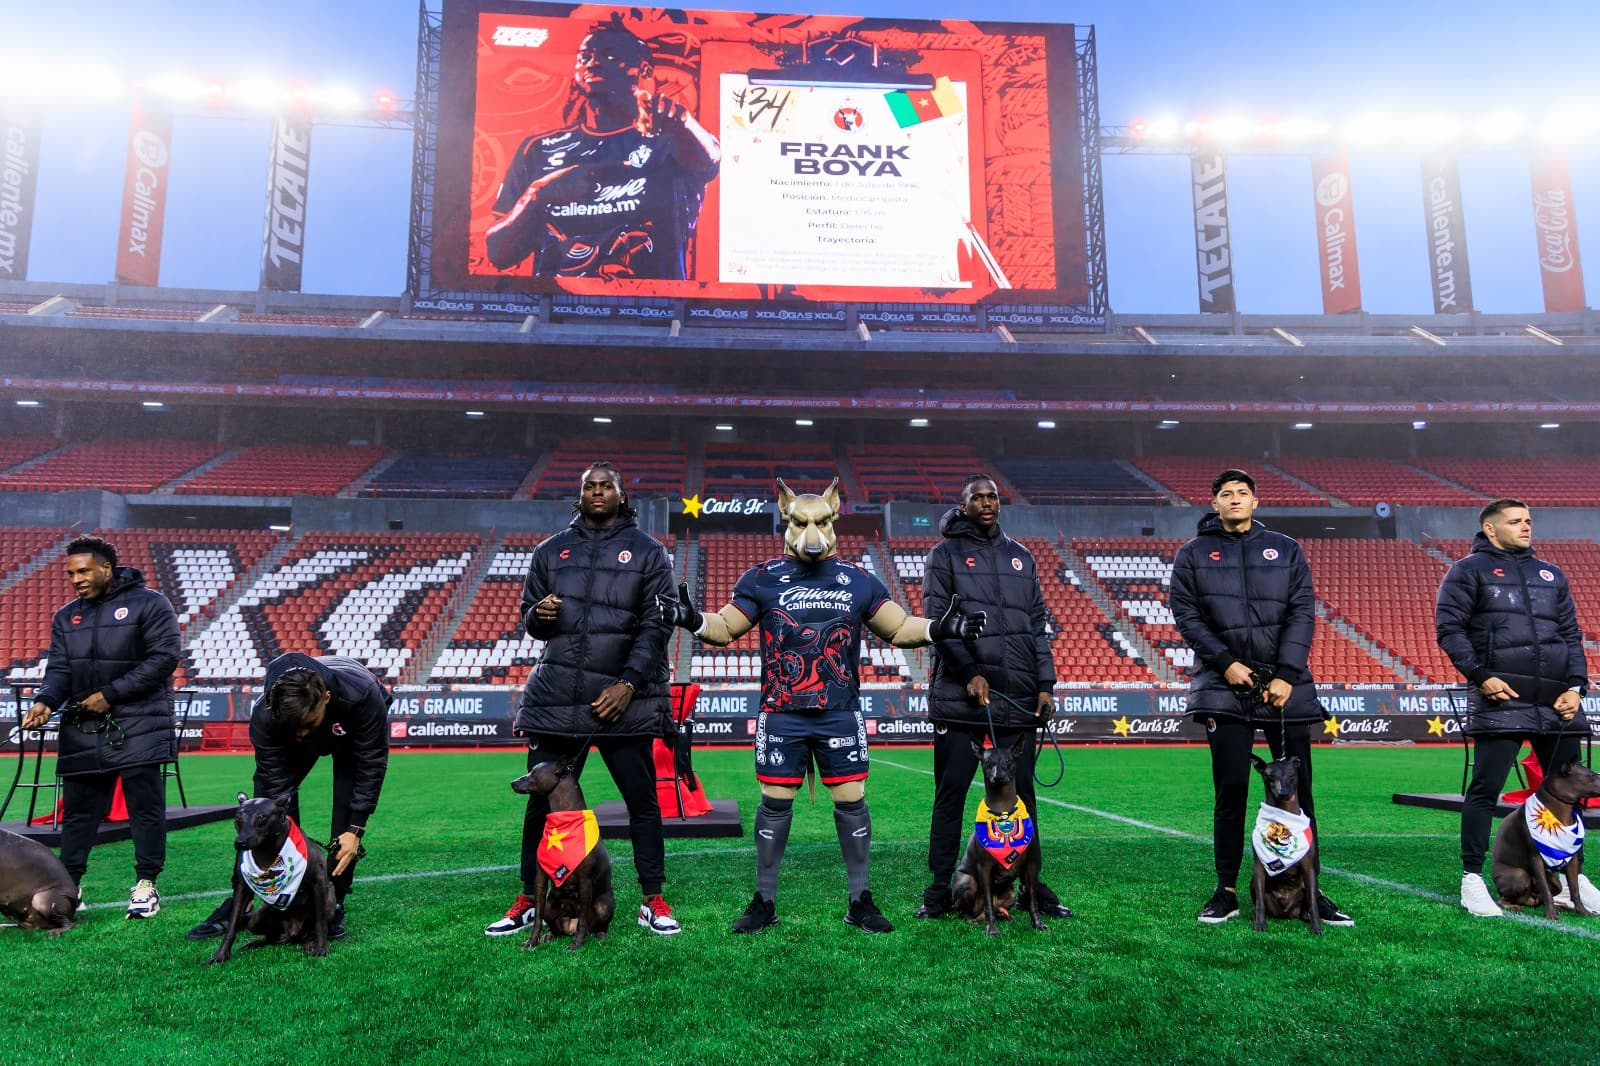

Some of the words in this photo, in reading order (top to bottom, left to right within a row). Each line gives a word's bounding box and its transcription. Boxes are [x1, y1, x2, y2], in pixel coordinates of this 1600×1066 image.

[780, 142, 911, 160] FRANK
[794, 158, 903, 177] BOYA
[269, 114, 309, 269] TECATE
[129, 167, 157, 257] Calimax
[806, 207, 852, 216] Estatura:
[808, 221, 838, 230] Perfil:
[1193, 153, 1232, 303] TECATE
[817, 235, 878, 245] Trayectoria:
[1430, 177, 1458, 308] caliente.mx
[1323, 208, 1345, 292] Calimax
[743, 498, 768, 514] Jr.
[778, 586, 853, 606] Caliente
[786, 600, 851, 612] caliente.mx
[424, 698, 483, 715] GRANDE
[1064, 696, 1118, 712] GRANDE
[1317, 696, 1365, 712] RANDE
[407, 722, 498, 737] caliente.mx
[877, 720, 935, 733] caliente
[1129, 718, 1163, 734] Carl's
[1339, 719, 1373, 733] Carl's
